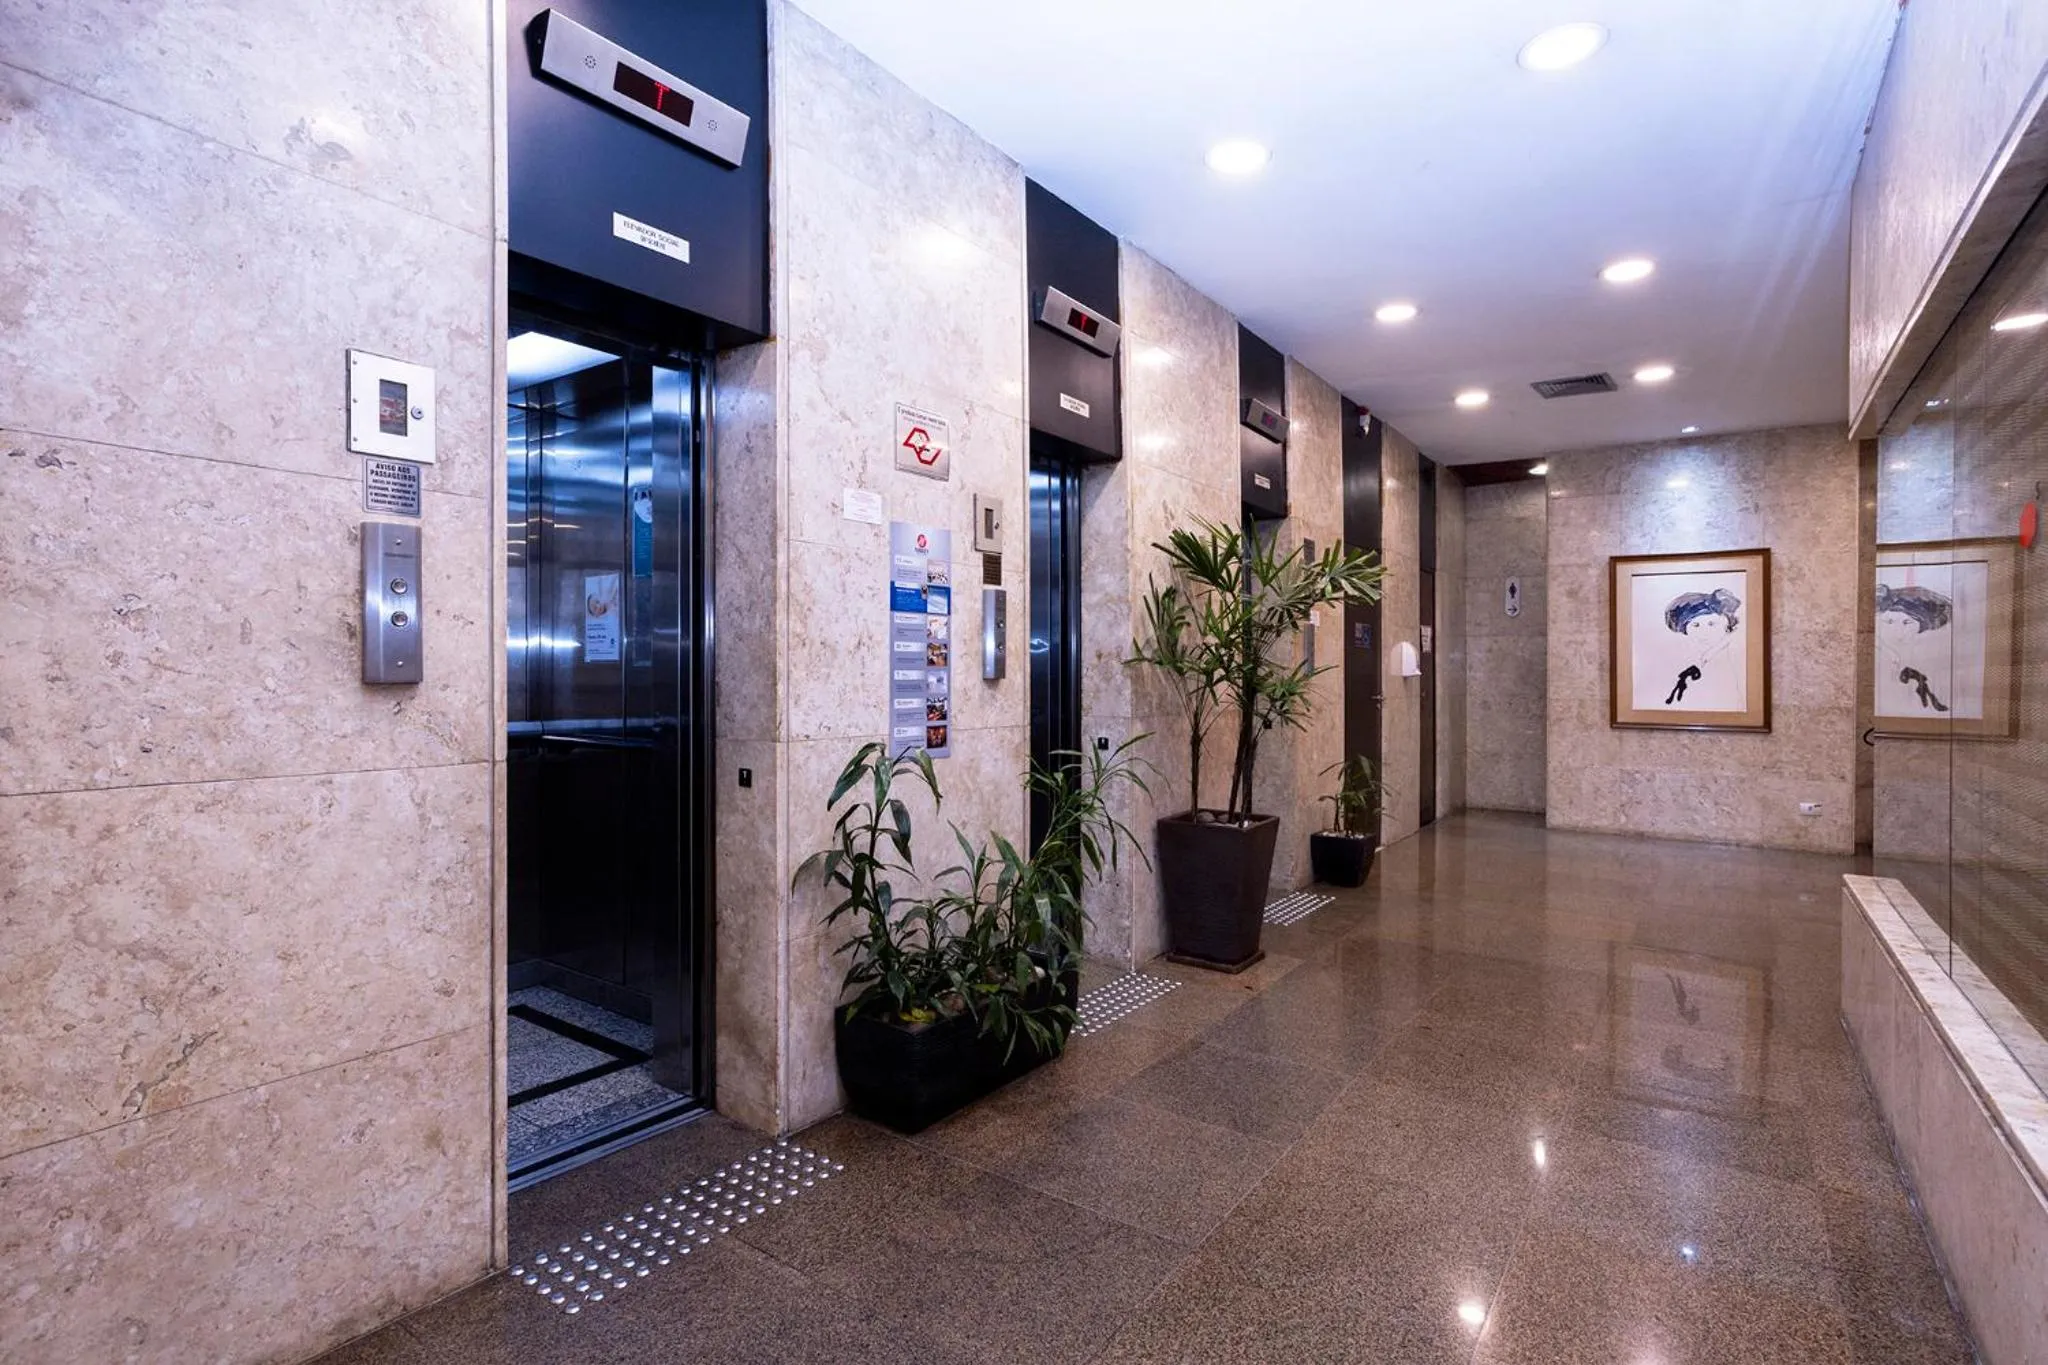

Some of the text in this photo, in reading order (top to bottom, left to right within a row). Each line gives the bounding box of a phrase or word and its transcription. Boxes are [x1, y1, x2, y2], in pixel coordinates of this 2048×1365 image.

[623, 220, 657, 238] ELEVADOR
[375, 463, 410, 474] AVISO AOS
[370, 469, 416, 482] PASSAGEIROS
